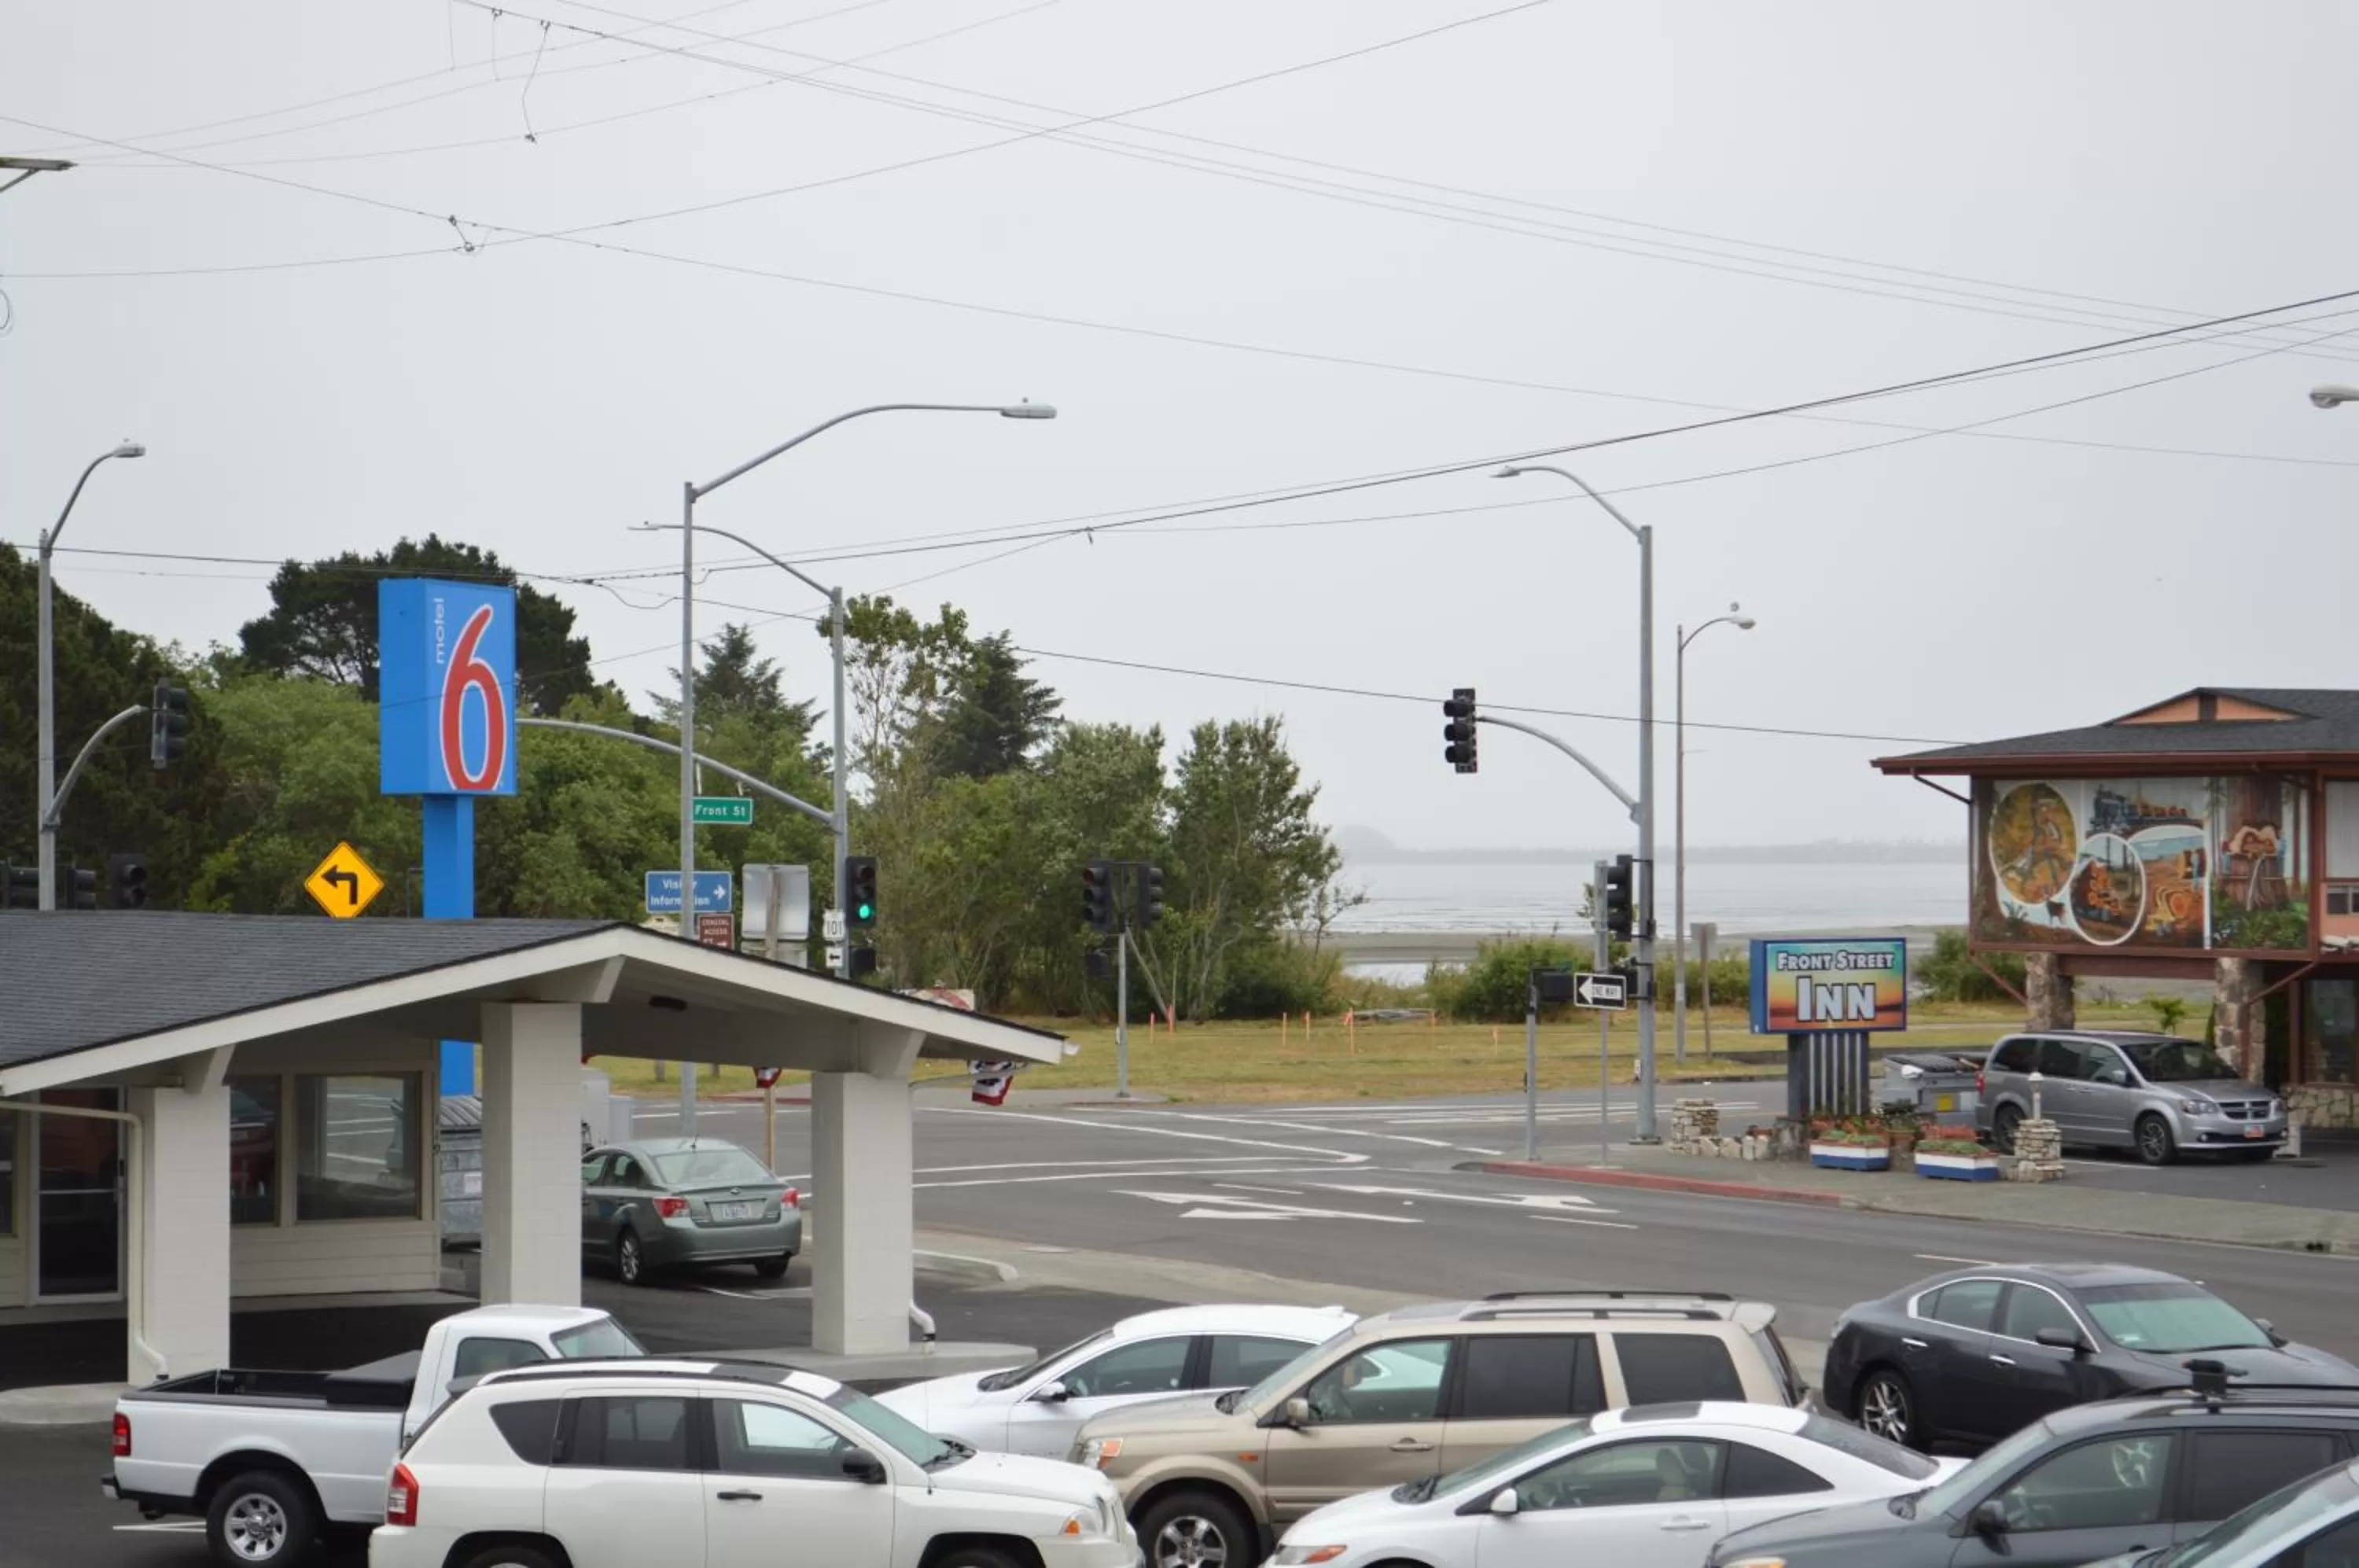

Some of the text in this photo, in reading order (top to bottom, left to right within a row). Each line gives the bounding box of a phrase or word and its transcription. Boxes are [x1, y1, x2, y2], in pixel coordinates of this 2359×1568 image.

[434, 597, 507, 790] motel 6
[694, 804, 746, 816] Front St
[650, 895, 710, 906] Informion
[826, 920, 842, 935] 101
[1777, 950, 1894, 970] FRONT STREET
[1798, 976, 1875, 1021] INN
